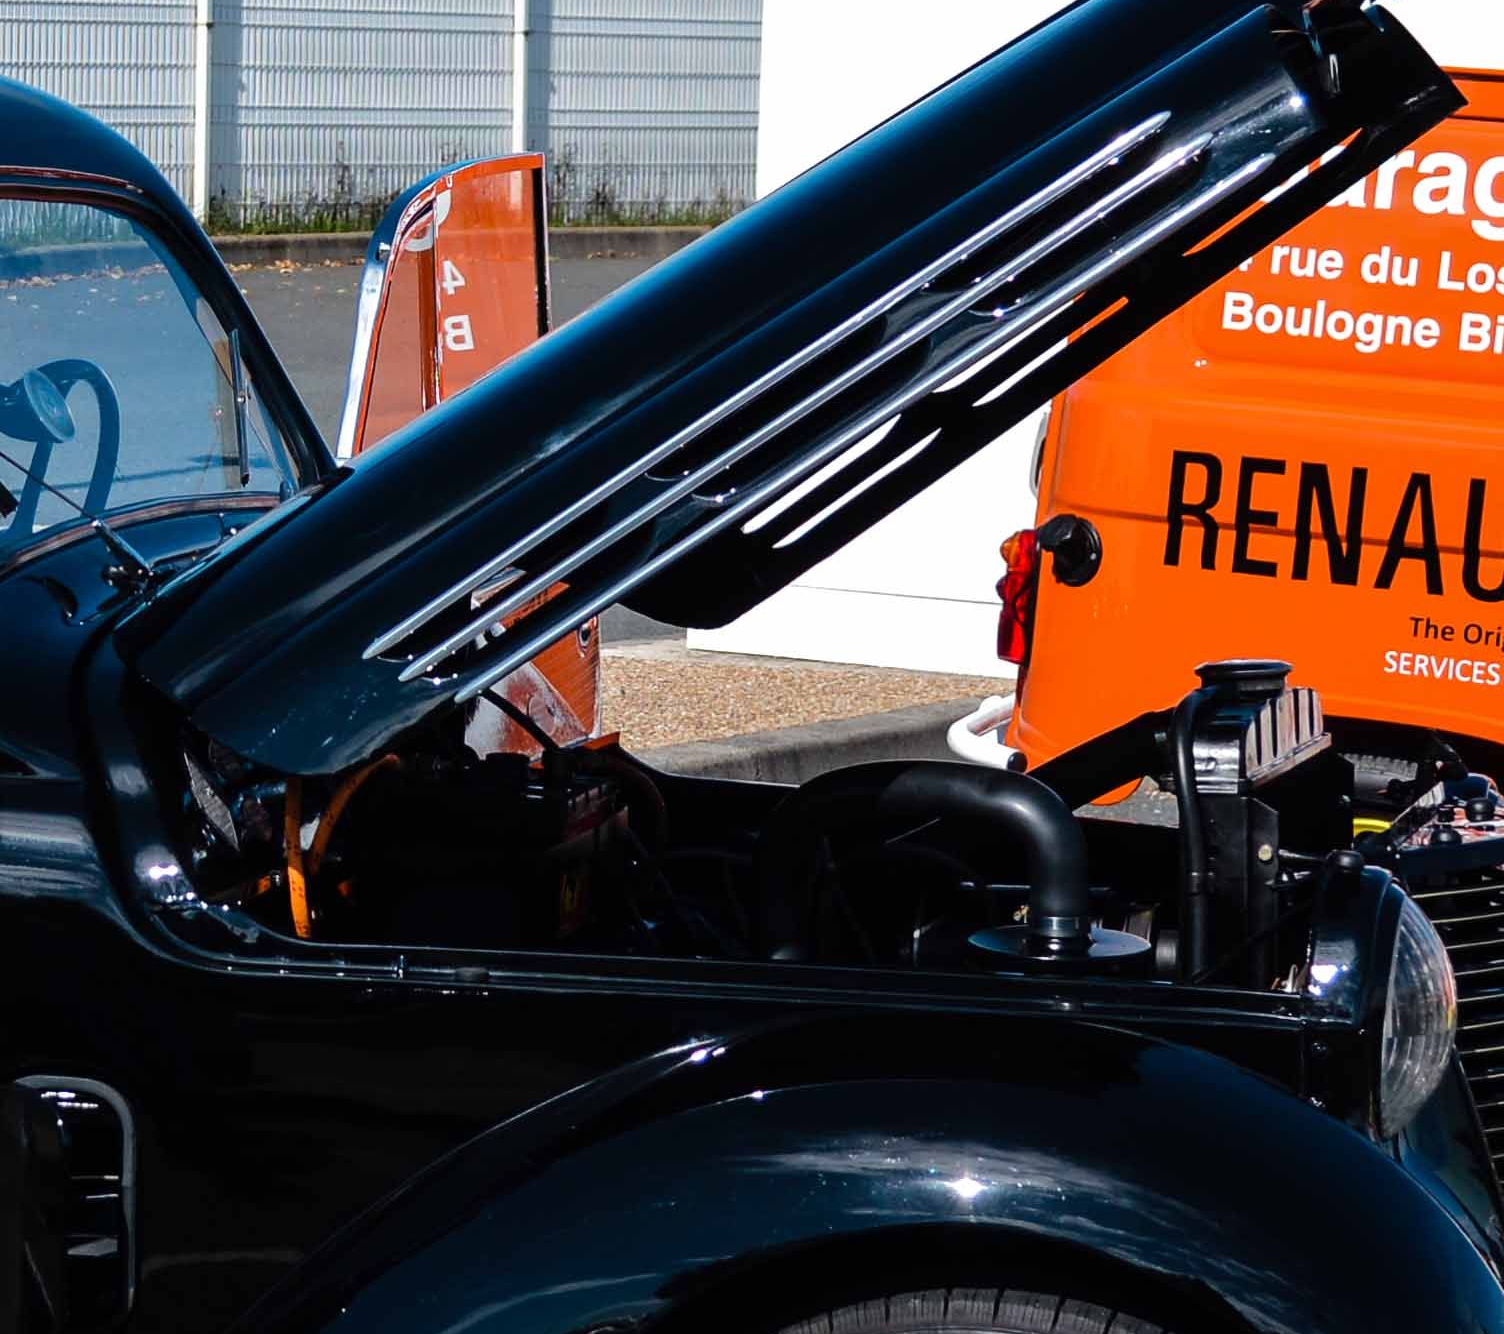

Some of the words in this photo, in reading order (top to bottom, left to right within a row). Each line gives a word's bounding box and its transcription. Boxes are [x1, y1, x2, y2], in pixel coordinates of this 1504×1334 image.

[1270, 244, 1343, 280] rue
[1361, 246, 1418, 287] du
[1221, 291, 1440, 353] Boulogne
[1409, 617, 1455, 642] The
[1383, 650, 1501, 685] SERVICES
